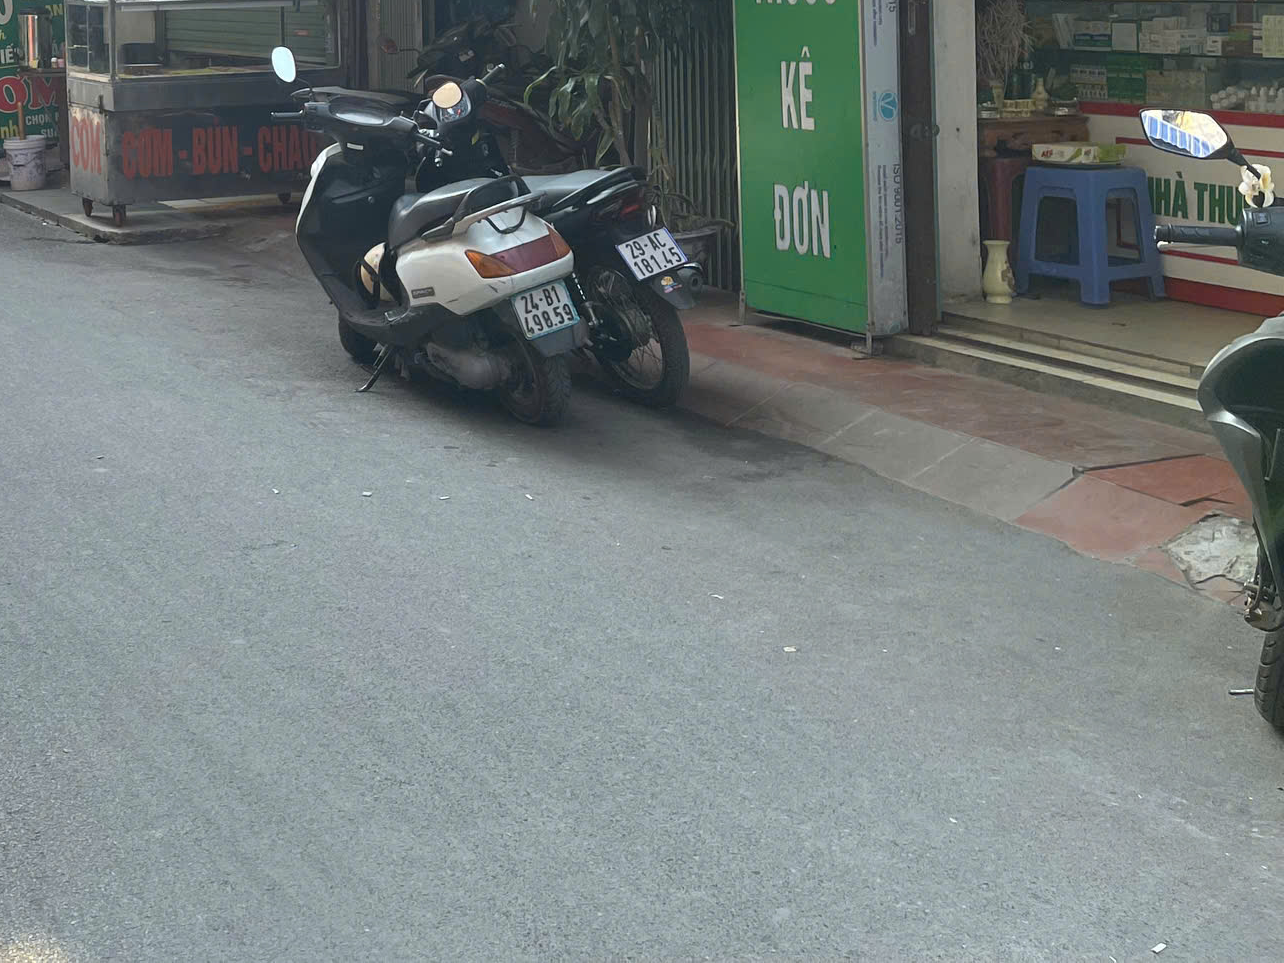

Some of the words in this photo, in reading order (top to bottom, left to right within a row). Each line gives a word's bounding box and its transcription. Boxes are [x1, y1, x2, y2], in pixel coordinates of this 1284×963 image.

[780, 46, 815, 131] KÊ
[774, 181, 831, 258] ĐƠN
[625, 232, 667, 260] 29-AC
[633, 247, 682, 277] 181.45
[520, 284, 562, 314] 24-B1
[524, 303, 574, 335] 498.59
